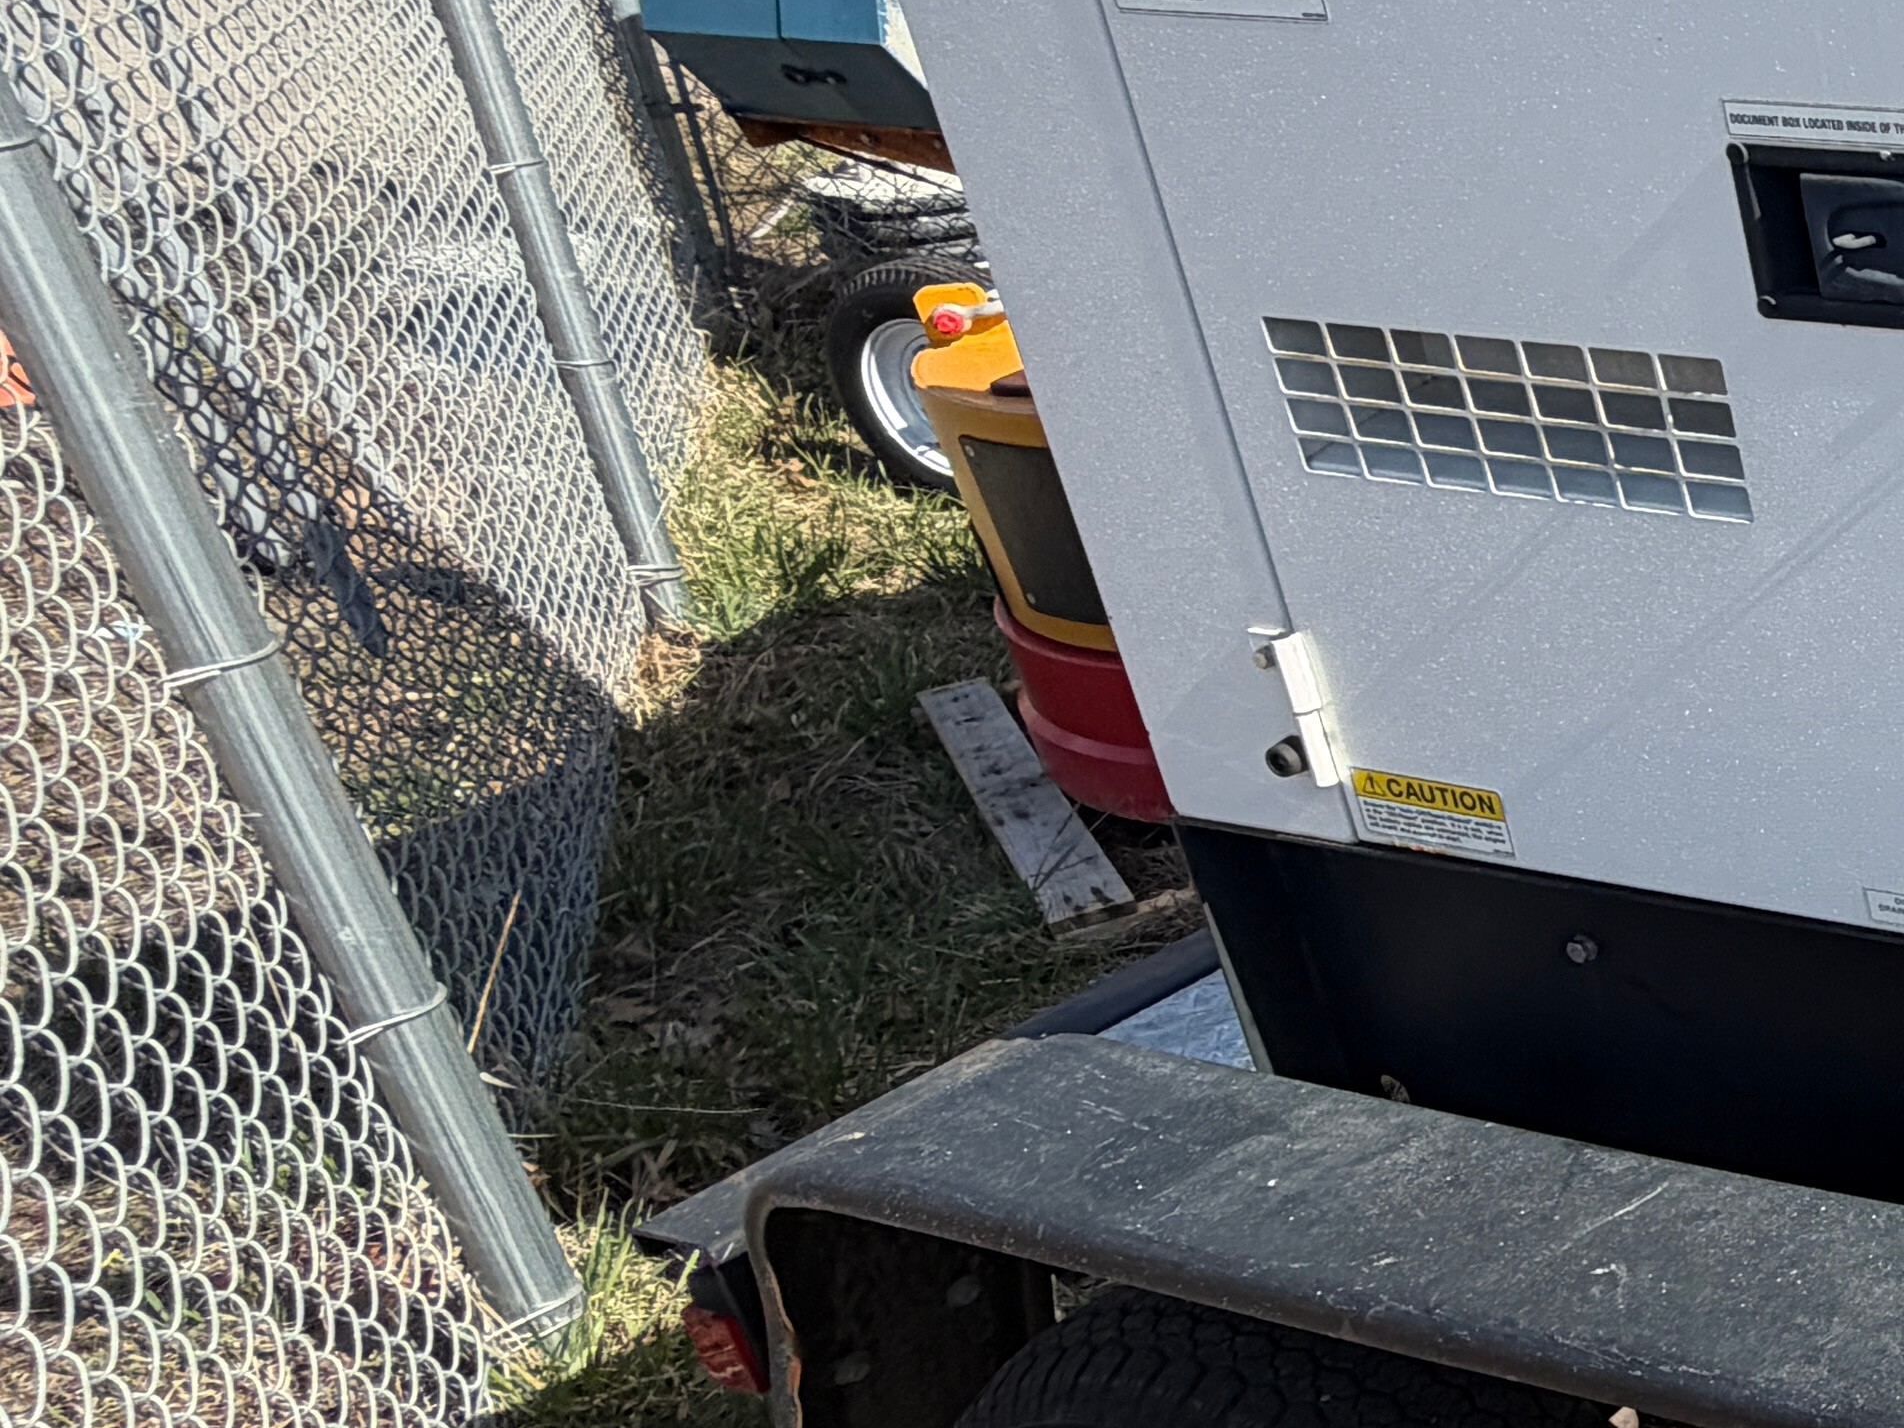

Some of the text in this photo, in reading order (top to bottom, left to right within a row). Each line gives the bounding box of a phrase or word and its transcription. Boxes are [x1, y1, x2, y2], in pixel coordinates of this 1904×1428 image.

[1729, 112, 1779, 128] DOCUMENT
[1782, 116, 1801, 129] BOX
[1802, 117, 1844, 131] LOCATED
[1846, 120, 1877, 134] INSIDE
[1879, 122, 1892, 134] OF
[1386, 778, 1496, 815] CAUTION
